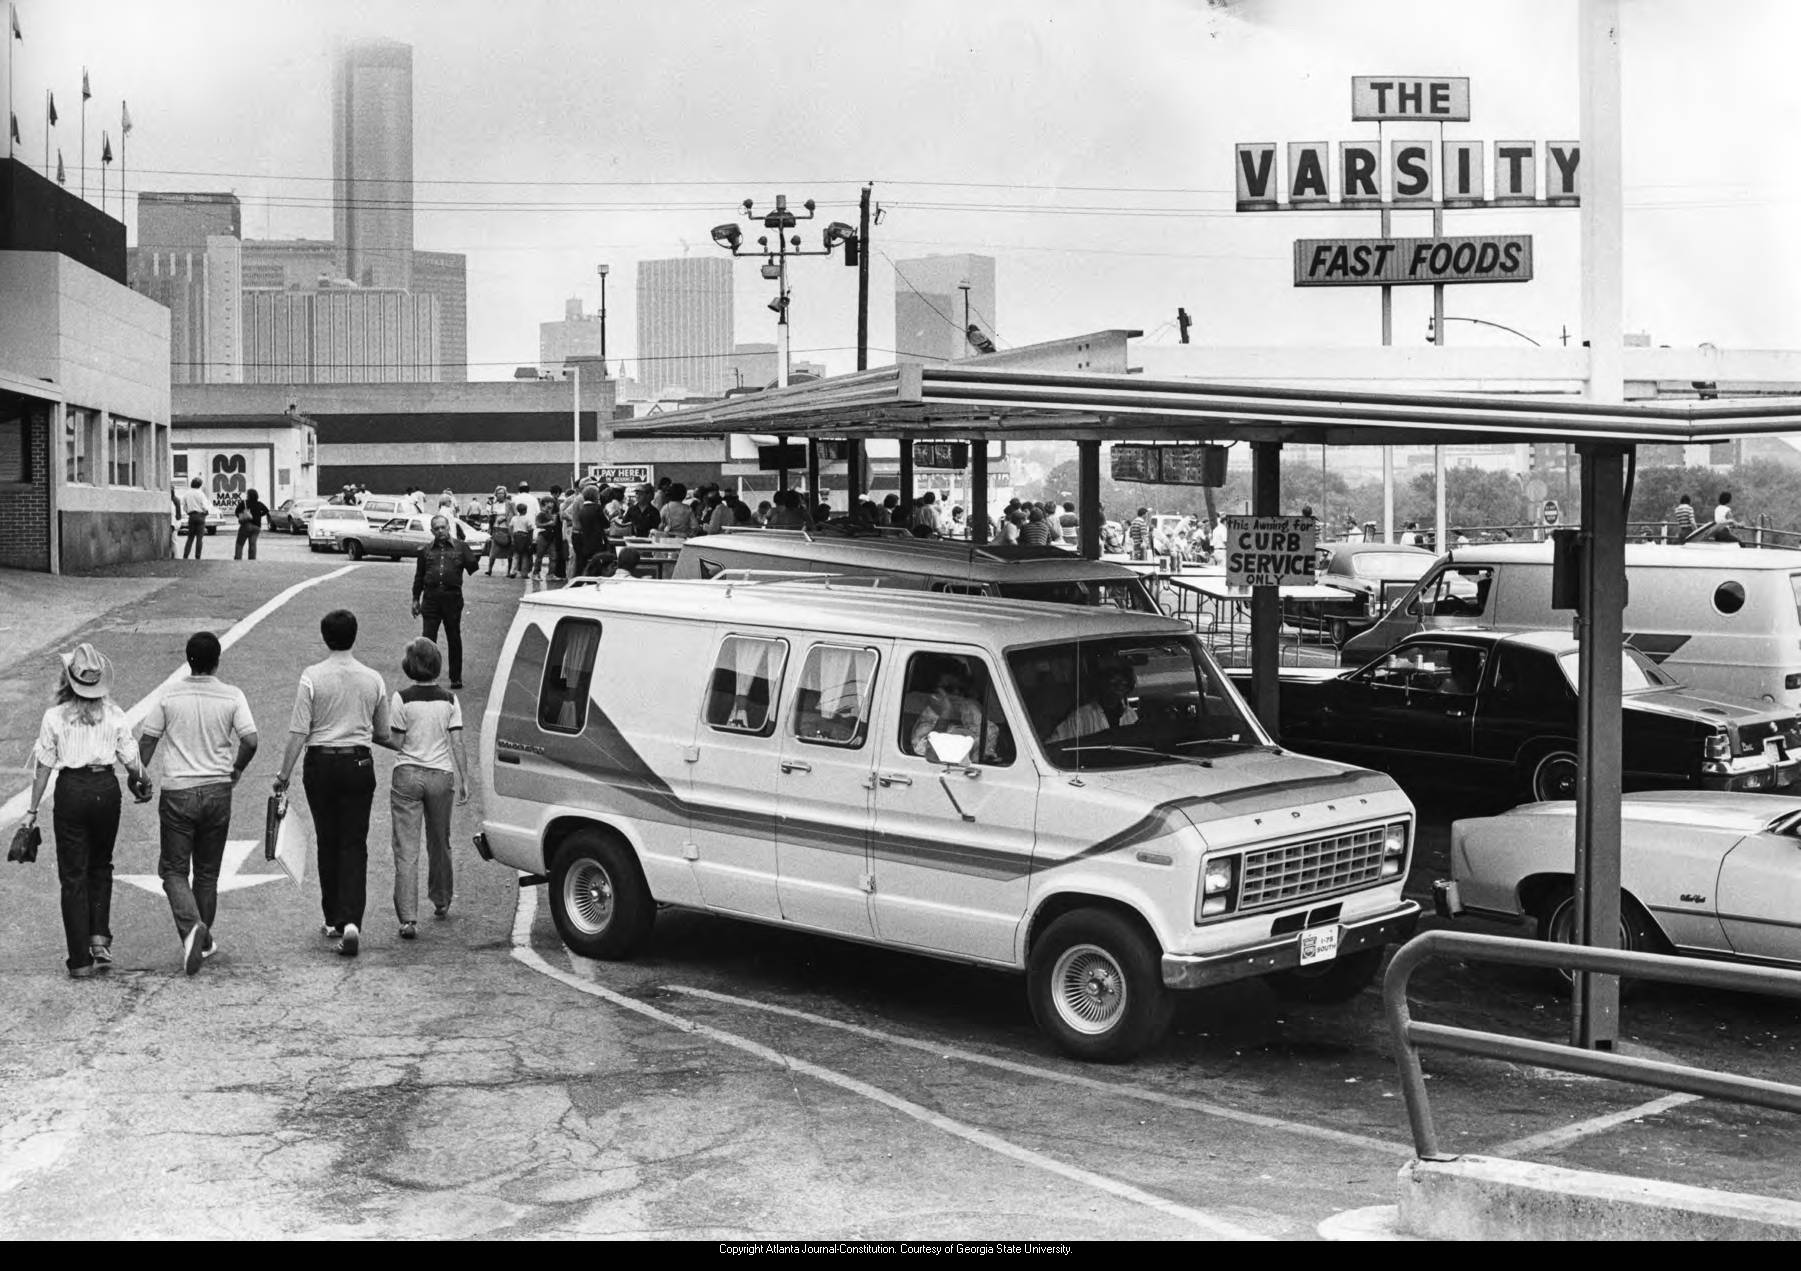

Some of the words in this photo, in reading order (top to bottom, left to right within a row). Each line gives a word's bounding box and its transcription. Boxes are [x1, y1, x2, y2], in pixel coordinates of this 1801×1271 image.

[1370, 82, 1450, 114] THE
[1239, 147, 1580, 197] VARSITY
[1309, 244, 1394, 277] FAST
[1409, 241, 1522, 275] FOODS
[601, 469, 616, 477] PAY
[618, 469, 639, 477] HERE
[1253, 518, 1289, 533] Awning
[1293, 518, 1313, 531] for
[1238, 532, 1301, 552] CURB
[1228, 553, 1316, 576] SERVICE
[1246, 574, 1285, 585] ONLY
[1254, 798, 1368, 825] FORD
